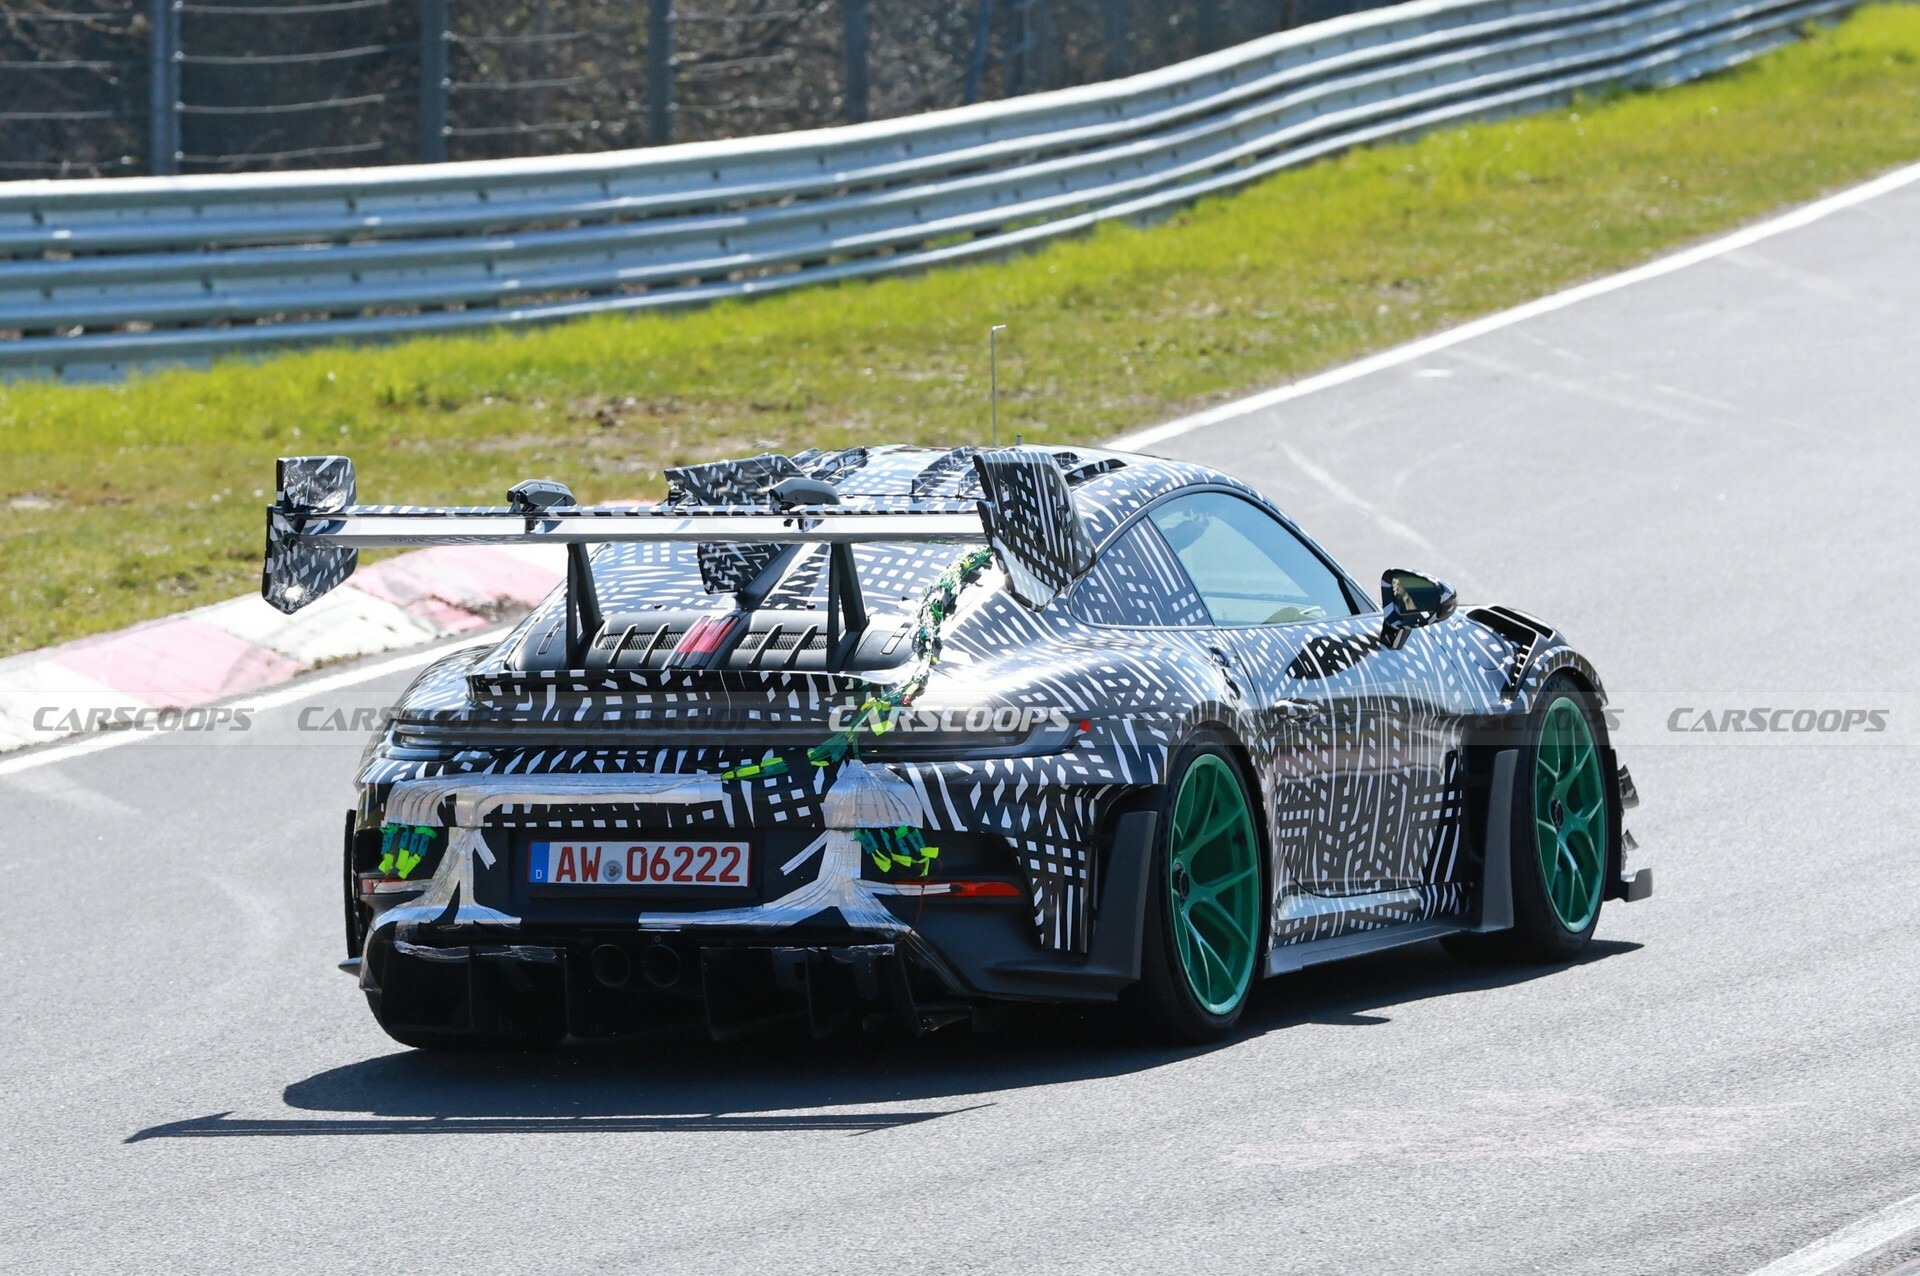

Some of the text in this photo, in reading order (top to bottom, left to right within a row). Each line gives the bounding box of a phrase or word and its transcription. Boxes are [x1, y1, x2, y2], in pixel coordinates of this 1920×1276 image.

[535, 869, 543, 880] D
[555, 846, 602, 882] AW
[626, 846, 741, 882] 06222
